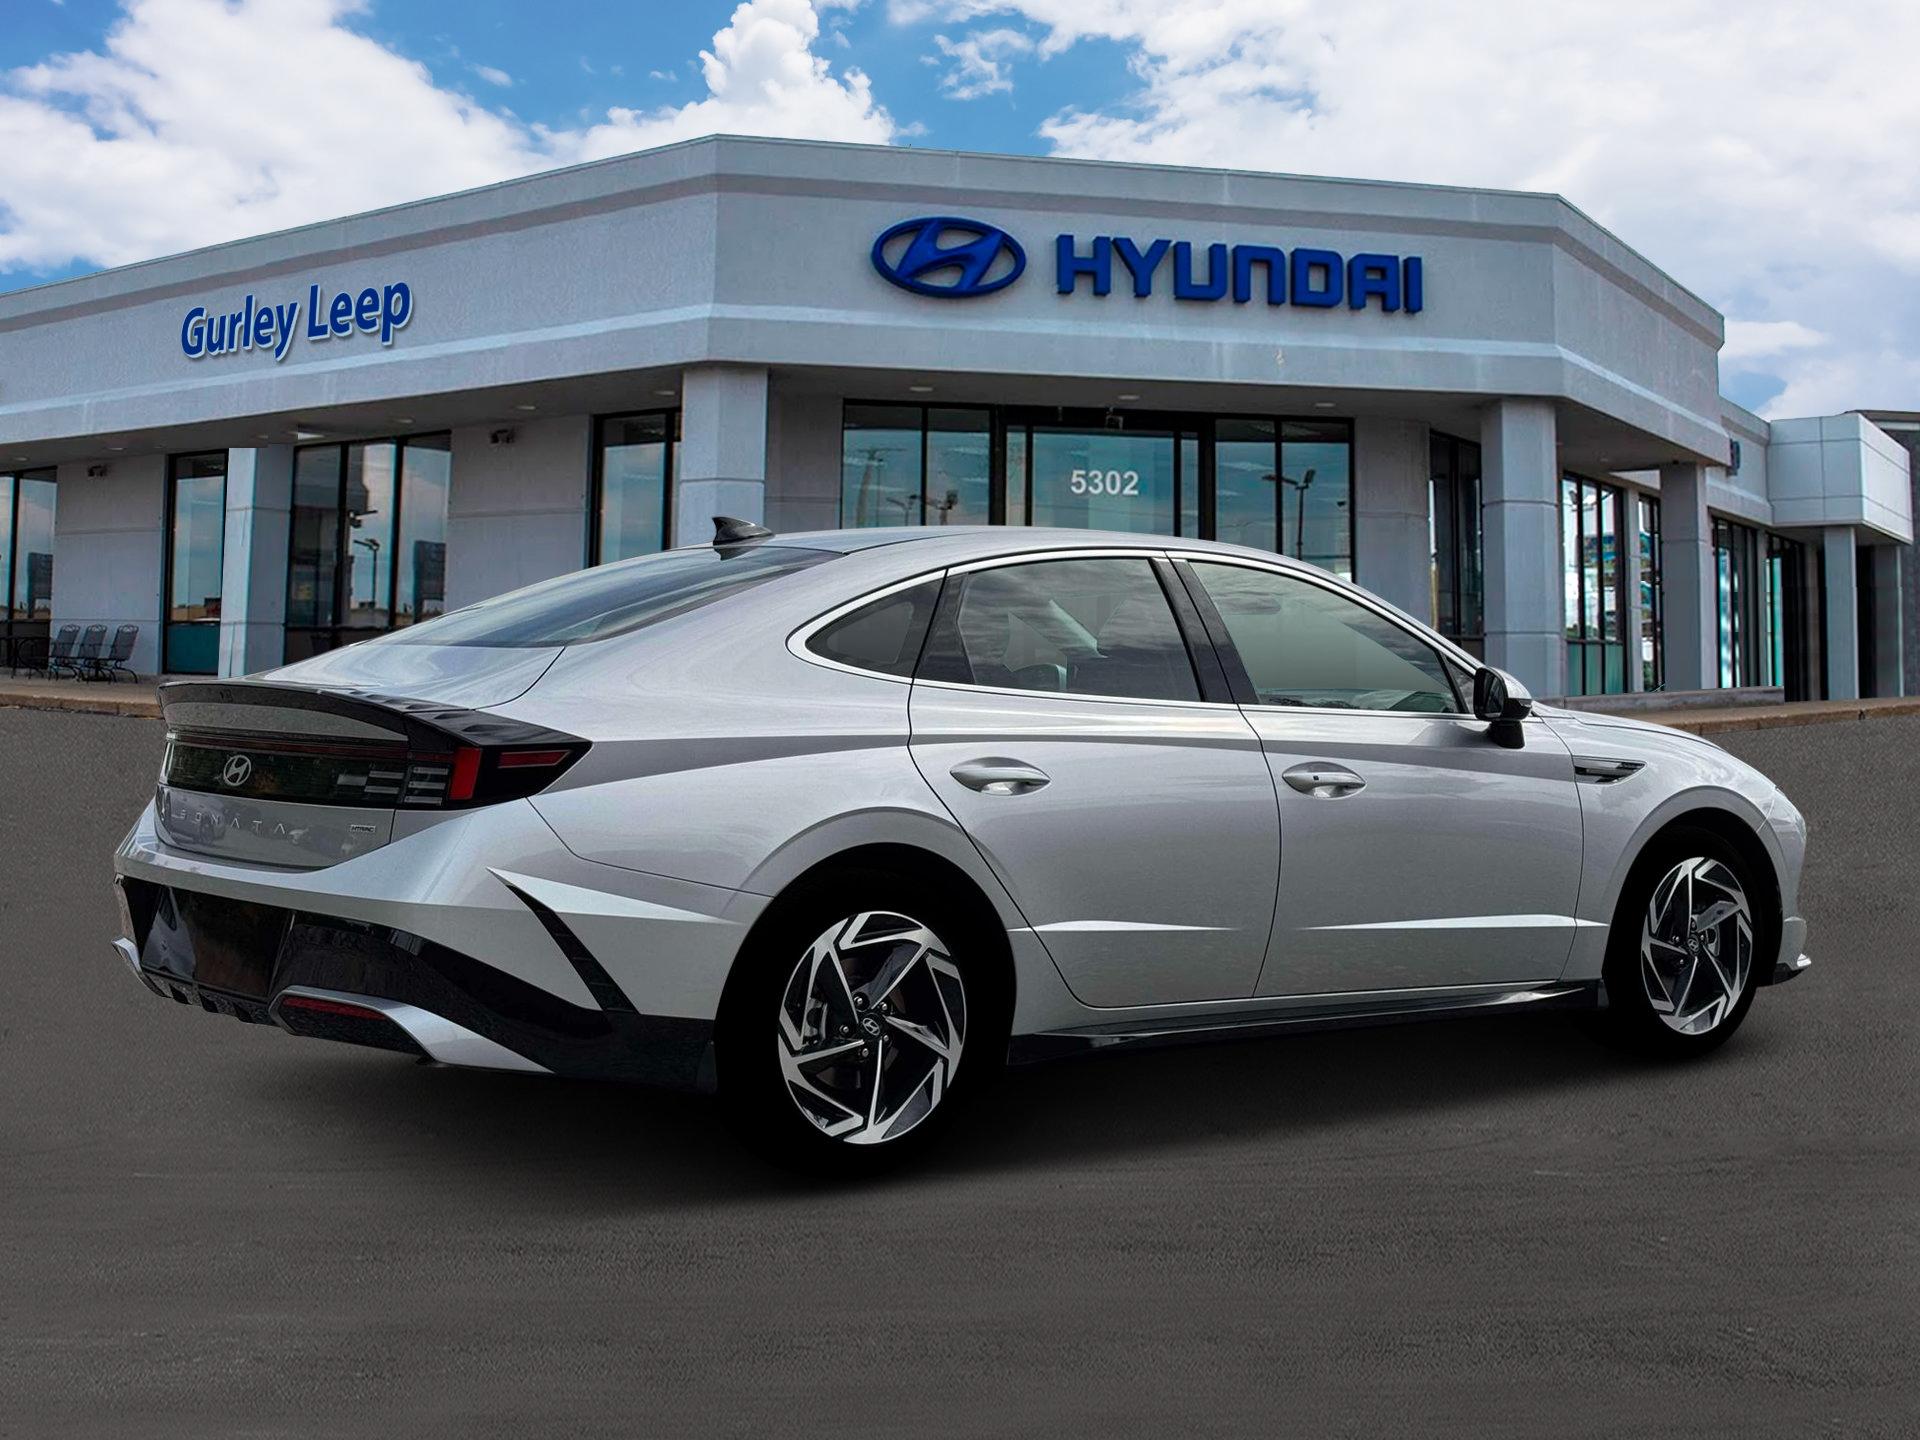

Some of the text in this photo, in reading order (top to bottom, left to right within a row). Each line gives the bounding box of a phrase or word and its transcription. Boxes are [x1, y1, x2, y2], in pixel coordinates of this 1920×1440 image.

[1056, 234, 1422, 314] HYUNDAI
[181, 282, 413, 361] Gurley Leep
[1070, 469, 1139, 495] 5302
